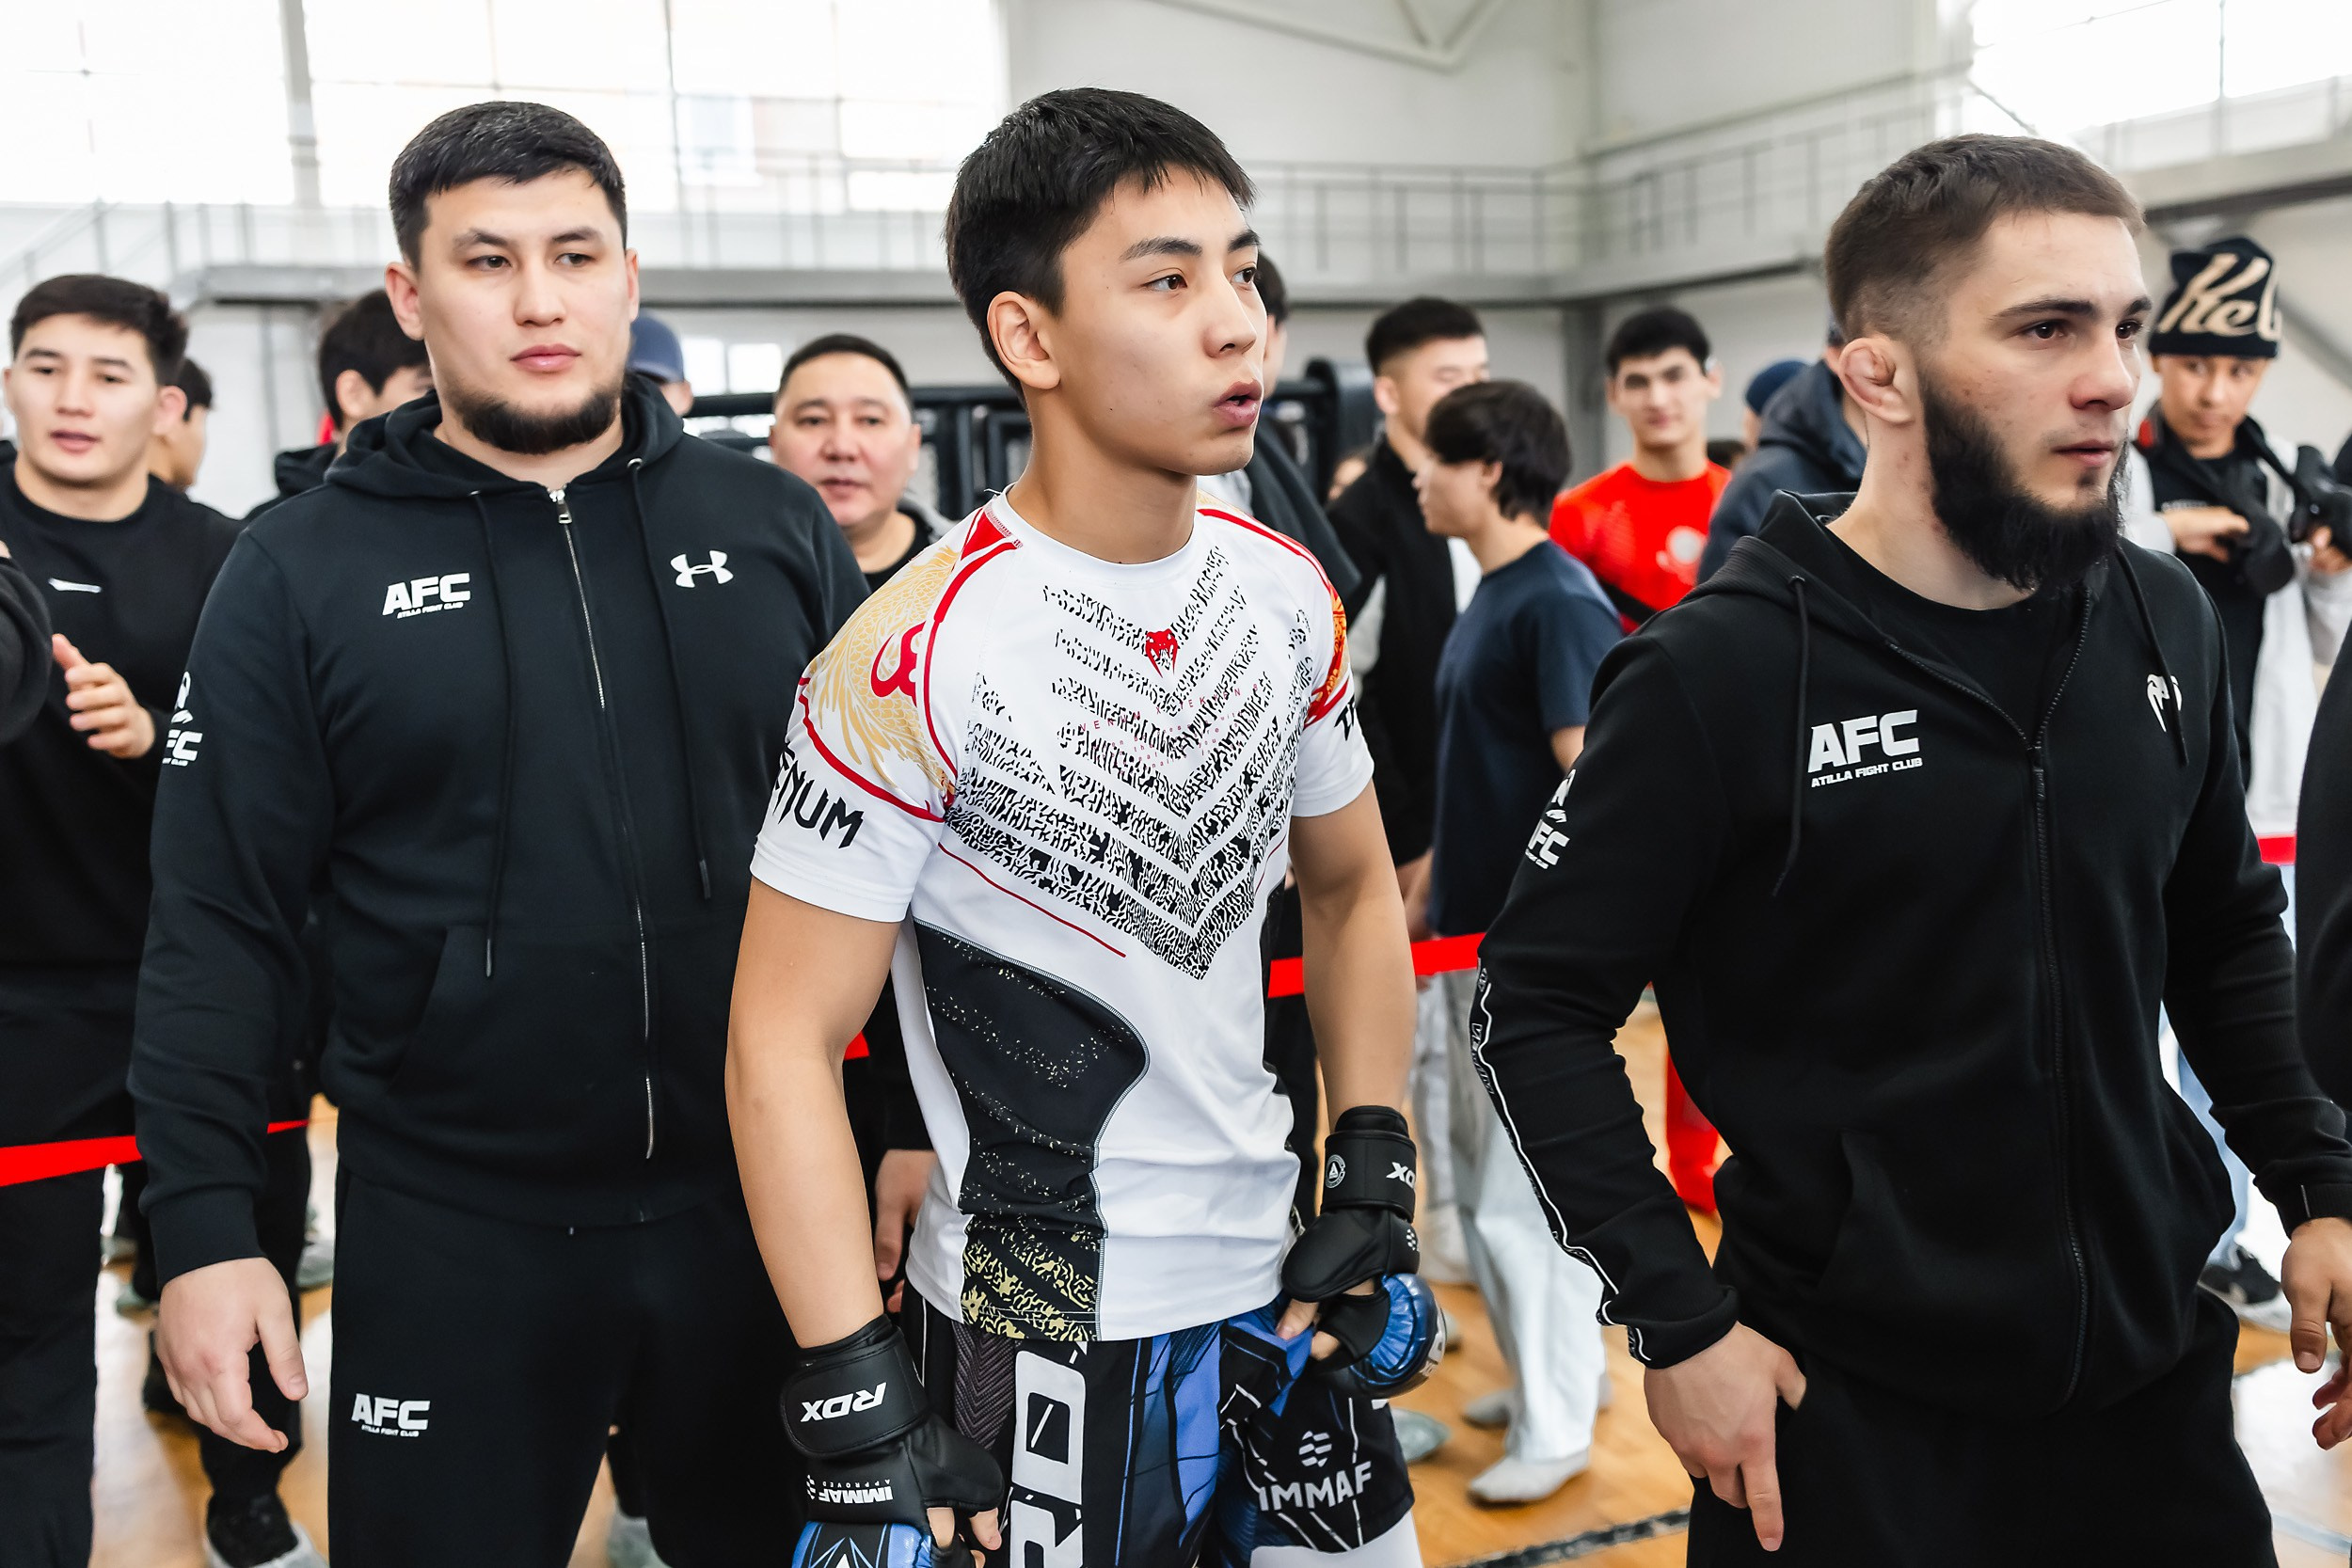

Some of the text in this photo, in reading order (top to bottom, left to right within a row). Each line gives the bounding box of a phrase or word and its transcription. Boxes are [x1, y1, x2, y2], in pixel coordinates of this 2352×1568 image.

[2158, 253, 2282, 341] Kel
[382, 572, 471, 616] AFC
[1807, 709, 1920, 773] AFC
[1811, 757, 1923, 788] ATILLA FIGHT CLUB
[1527, 818, 1570, 865] FC
[351, 1392, 431, 1431] AFC
[800, 1382, 887, 1423] RDX
[818, 1485, 894, 1504] IMMAF
[822, 1479, 891, 1488] APPROVED
[1258, 1461, 1373, 1512] IMMAF
